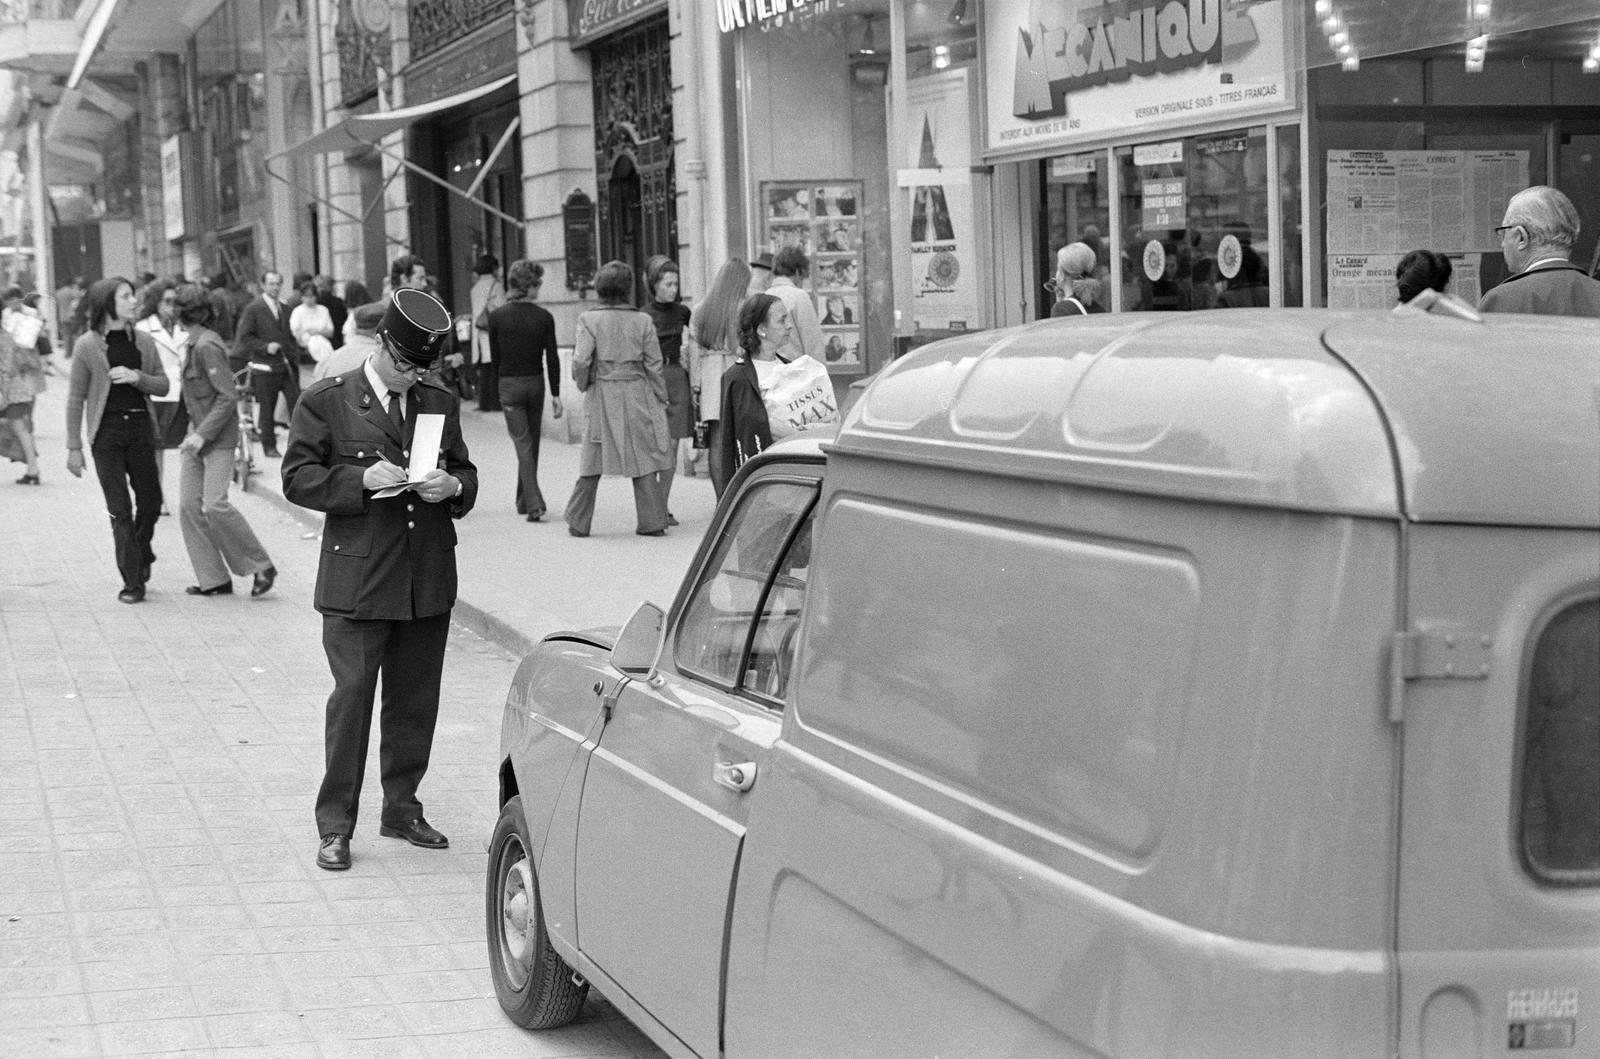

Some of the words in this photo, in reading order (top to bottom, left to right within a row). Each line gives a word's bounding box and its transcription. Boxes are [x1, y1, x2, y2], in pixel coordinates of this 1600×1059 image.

[1135, 105, 1160, 119] VERSION
[1160, 97, 1193, 114] ORIGINALE
[1194, 96, 1214, 109] SOUS
[1219, 90, 1242, 104] TITRES
[1332, 267, 1362, 278] Orange
[786, 385, 823, 412] TISSUS
[788, 395, 837, 430] MAX
